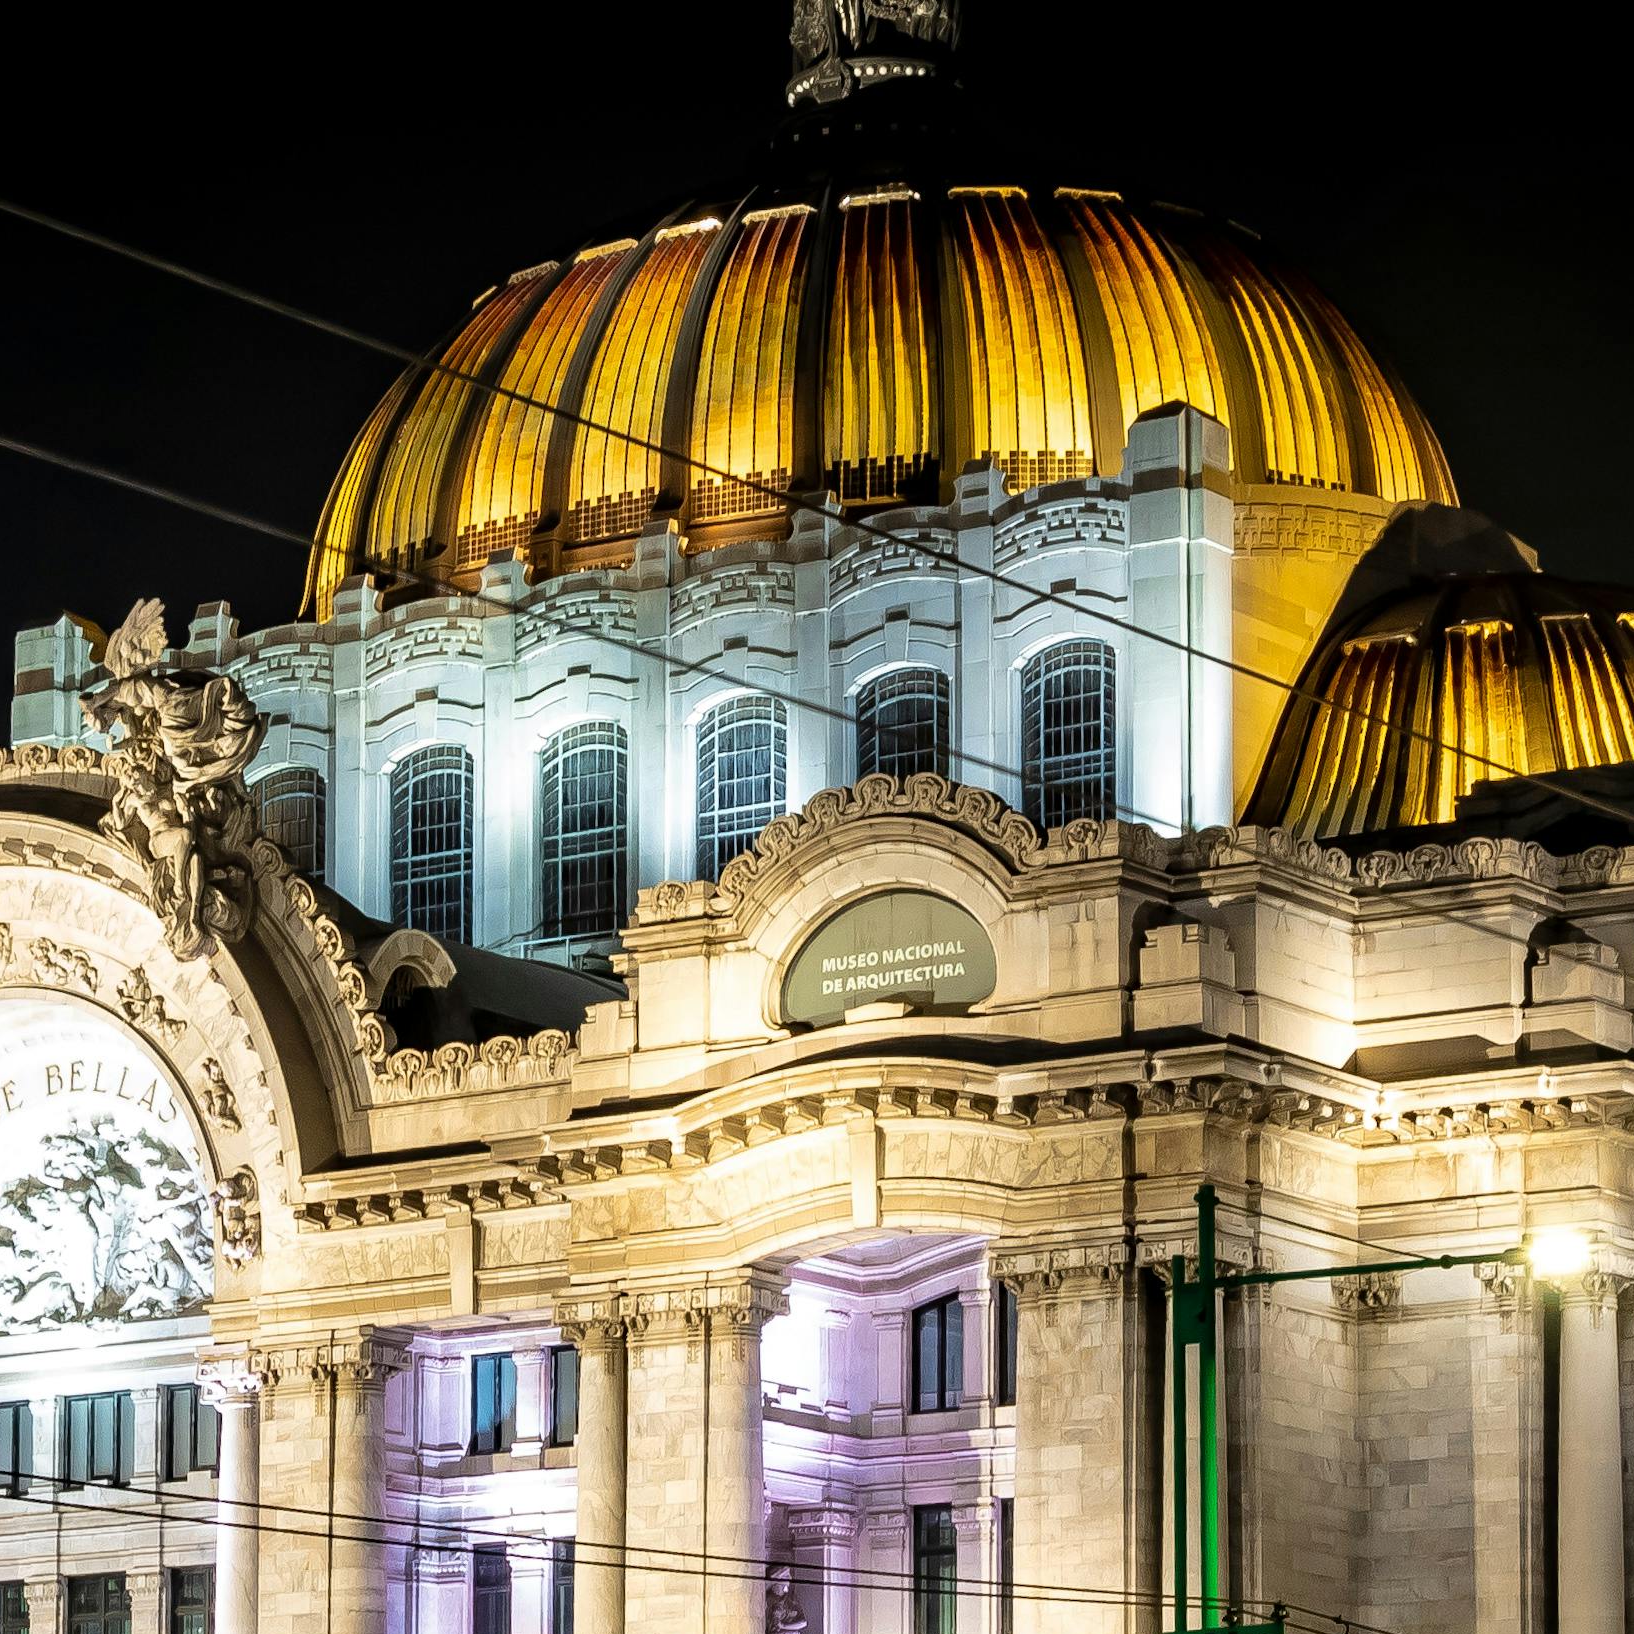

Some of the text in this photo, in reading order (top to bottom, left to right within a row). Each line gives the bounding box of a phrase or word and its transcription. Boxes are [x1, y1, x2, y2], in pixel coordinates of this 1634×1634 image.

[822, 940, 965, 973] MUSEO NACIONAL
[822, 963, 965, 994] DE ARQUITECTURA
[45, 1059, 178, 1124] BELLAS
